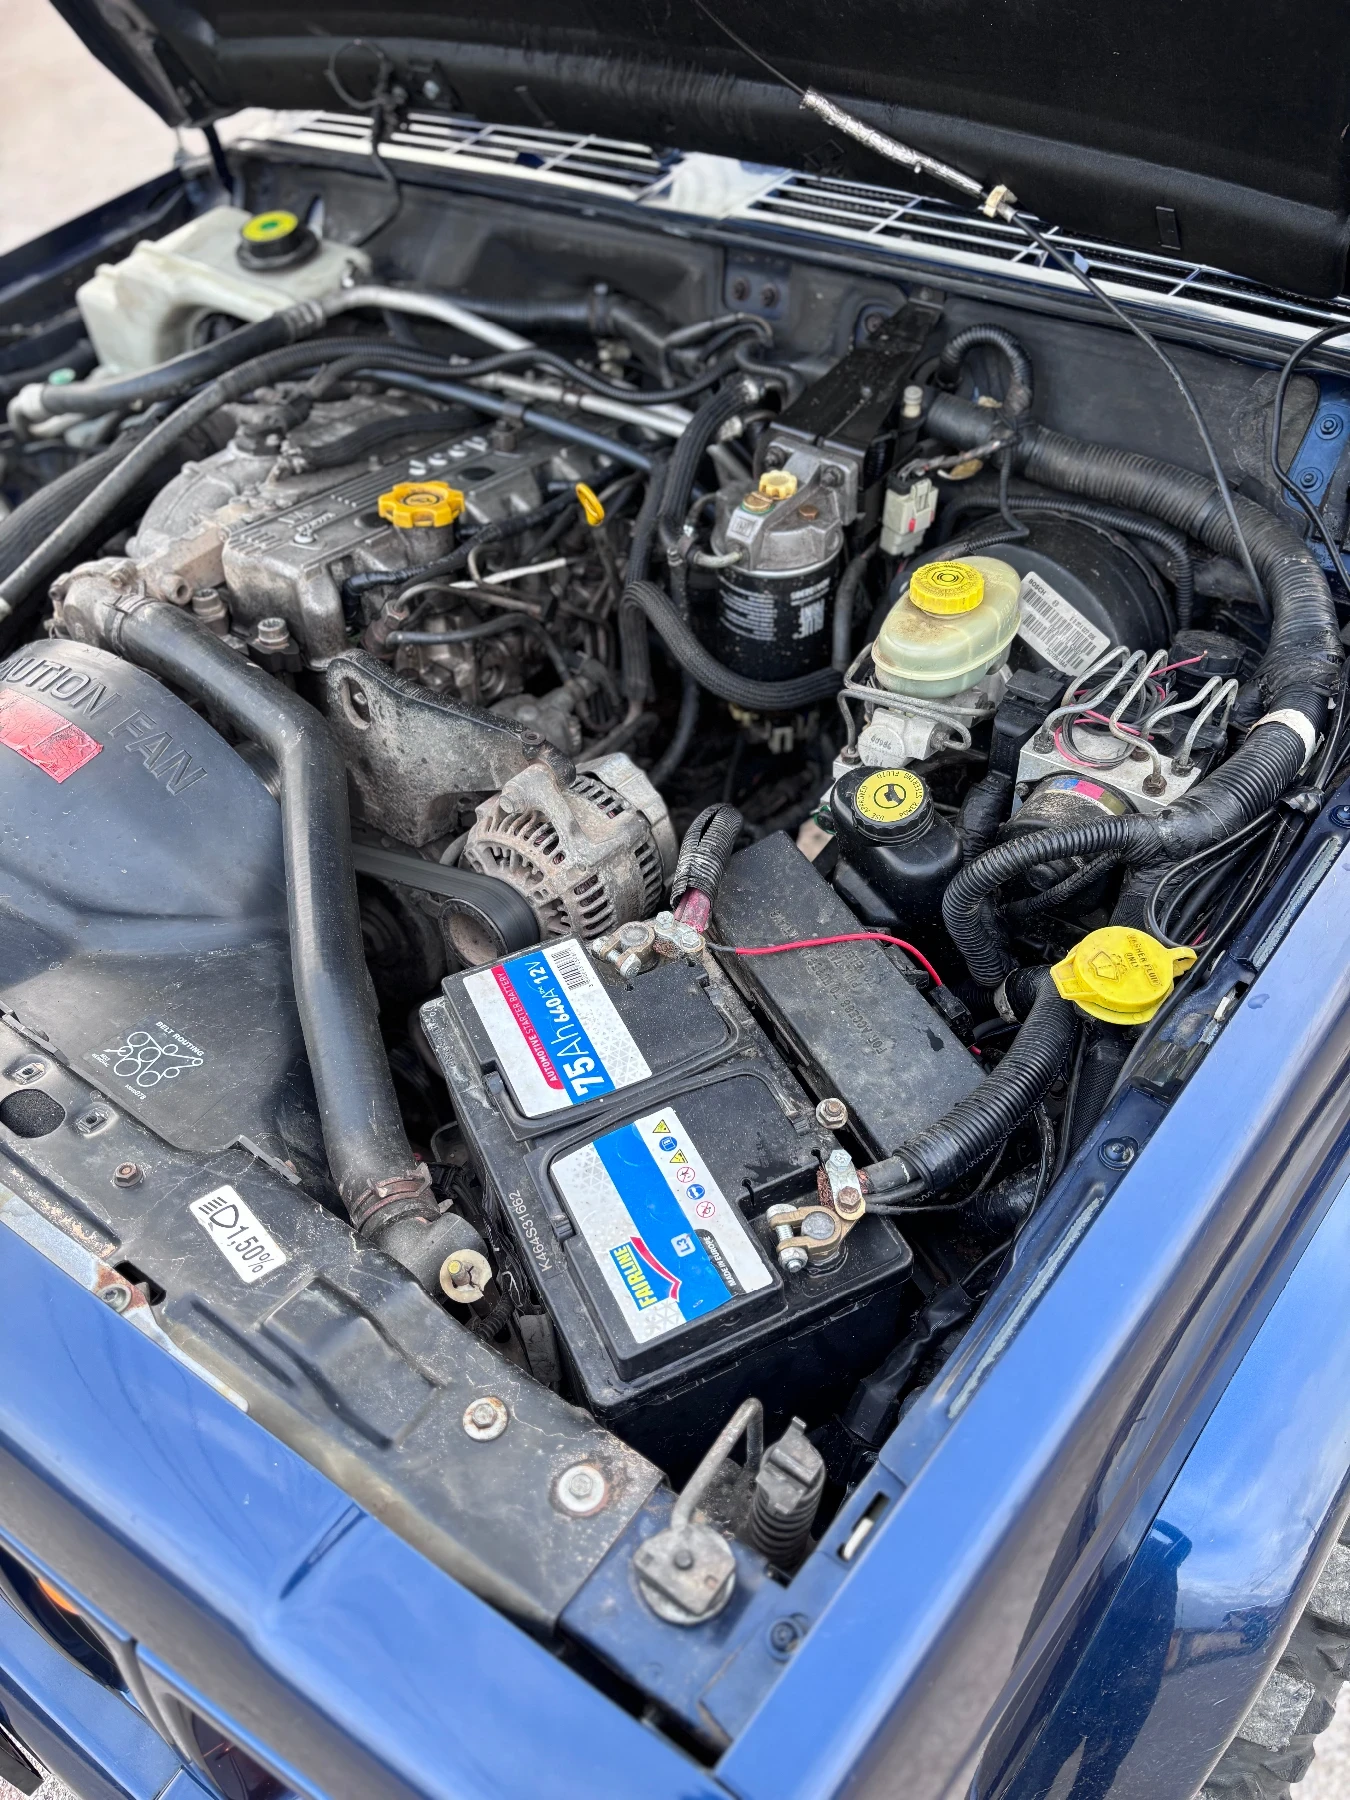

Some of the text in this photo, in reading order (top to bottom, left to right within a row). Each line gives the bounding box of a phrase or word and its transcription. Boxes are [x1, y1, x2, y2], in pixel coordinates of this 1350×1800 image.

[1028, 578, 1046, 596] BOSCH
[107, 709, 208, 796] FAN
[876, 771, 900, 779] FLUID
[903, 772, 923, 799] STEERING
[857, 785, 885, 821] USE APPROVED
[899, 802, 919, 818] POWER
[1126, 952, 1140, 968] ONLY
[1127, 934, 1148, 963] WASHER
[524, 961, 549, 985] 12V
[155, 1021, 205, 1057] BELT ROUTING
[496, 973, 558, 1082] AUTOMOTIVE STARTER BATTERY
[550, 1023, 605, 1097] 75Ah
[508, 1189, 553, 1272] K464S31662
[227, 1226, 274, 1273] 1,50%
[676, 1237, 691, 1253] L3
[703, 1235, 721, 1261] EUROPE
[613, 1244, 658, 1308] FAIRLINE
[720, 1267, 737, 1287] MADE
